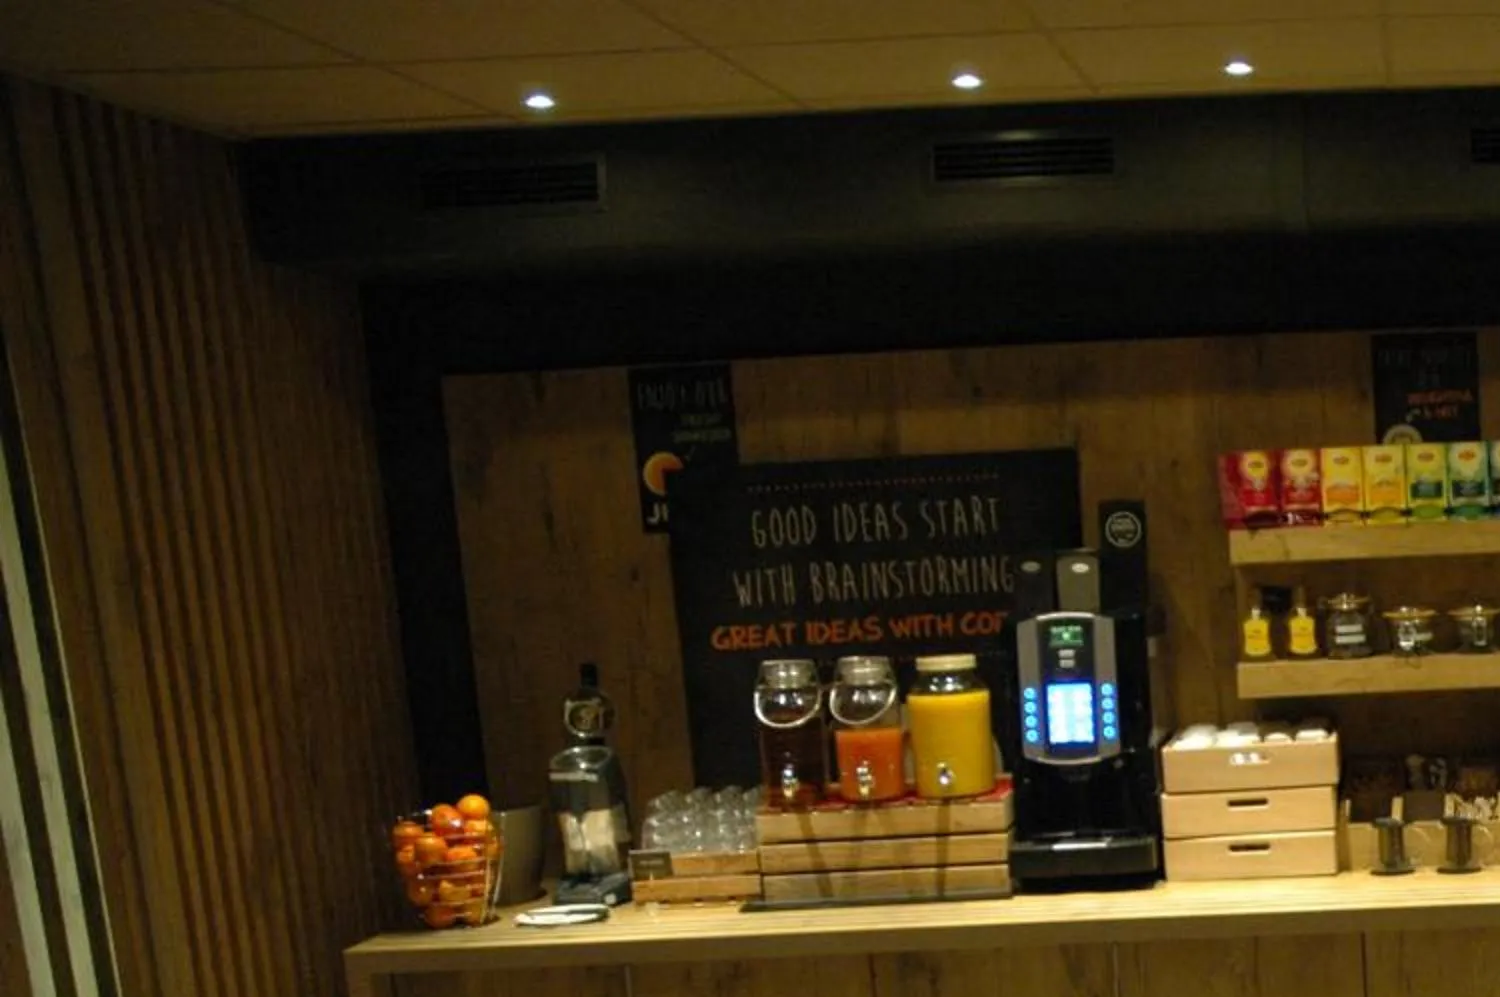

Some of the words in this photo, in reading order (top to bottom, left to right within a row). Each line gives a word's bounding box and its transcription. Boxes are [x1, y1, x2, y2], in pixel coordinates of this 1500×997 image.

[751, 504, 817, 548] GOOD
[832, 500, 909, 543] IDEAS
[920, 495, 999, 540] START
[732, 562, 798, 609] WITH
[808, 554, 1015, 604] BRAINSTORMING
[710, 620, 798, 652] GREAT
[804, 614, 885, 645] IDEAS
[887, 610, 955, 639] WITH
